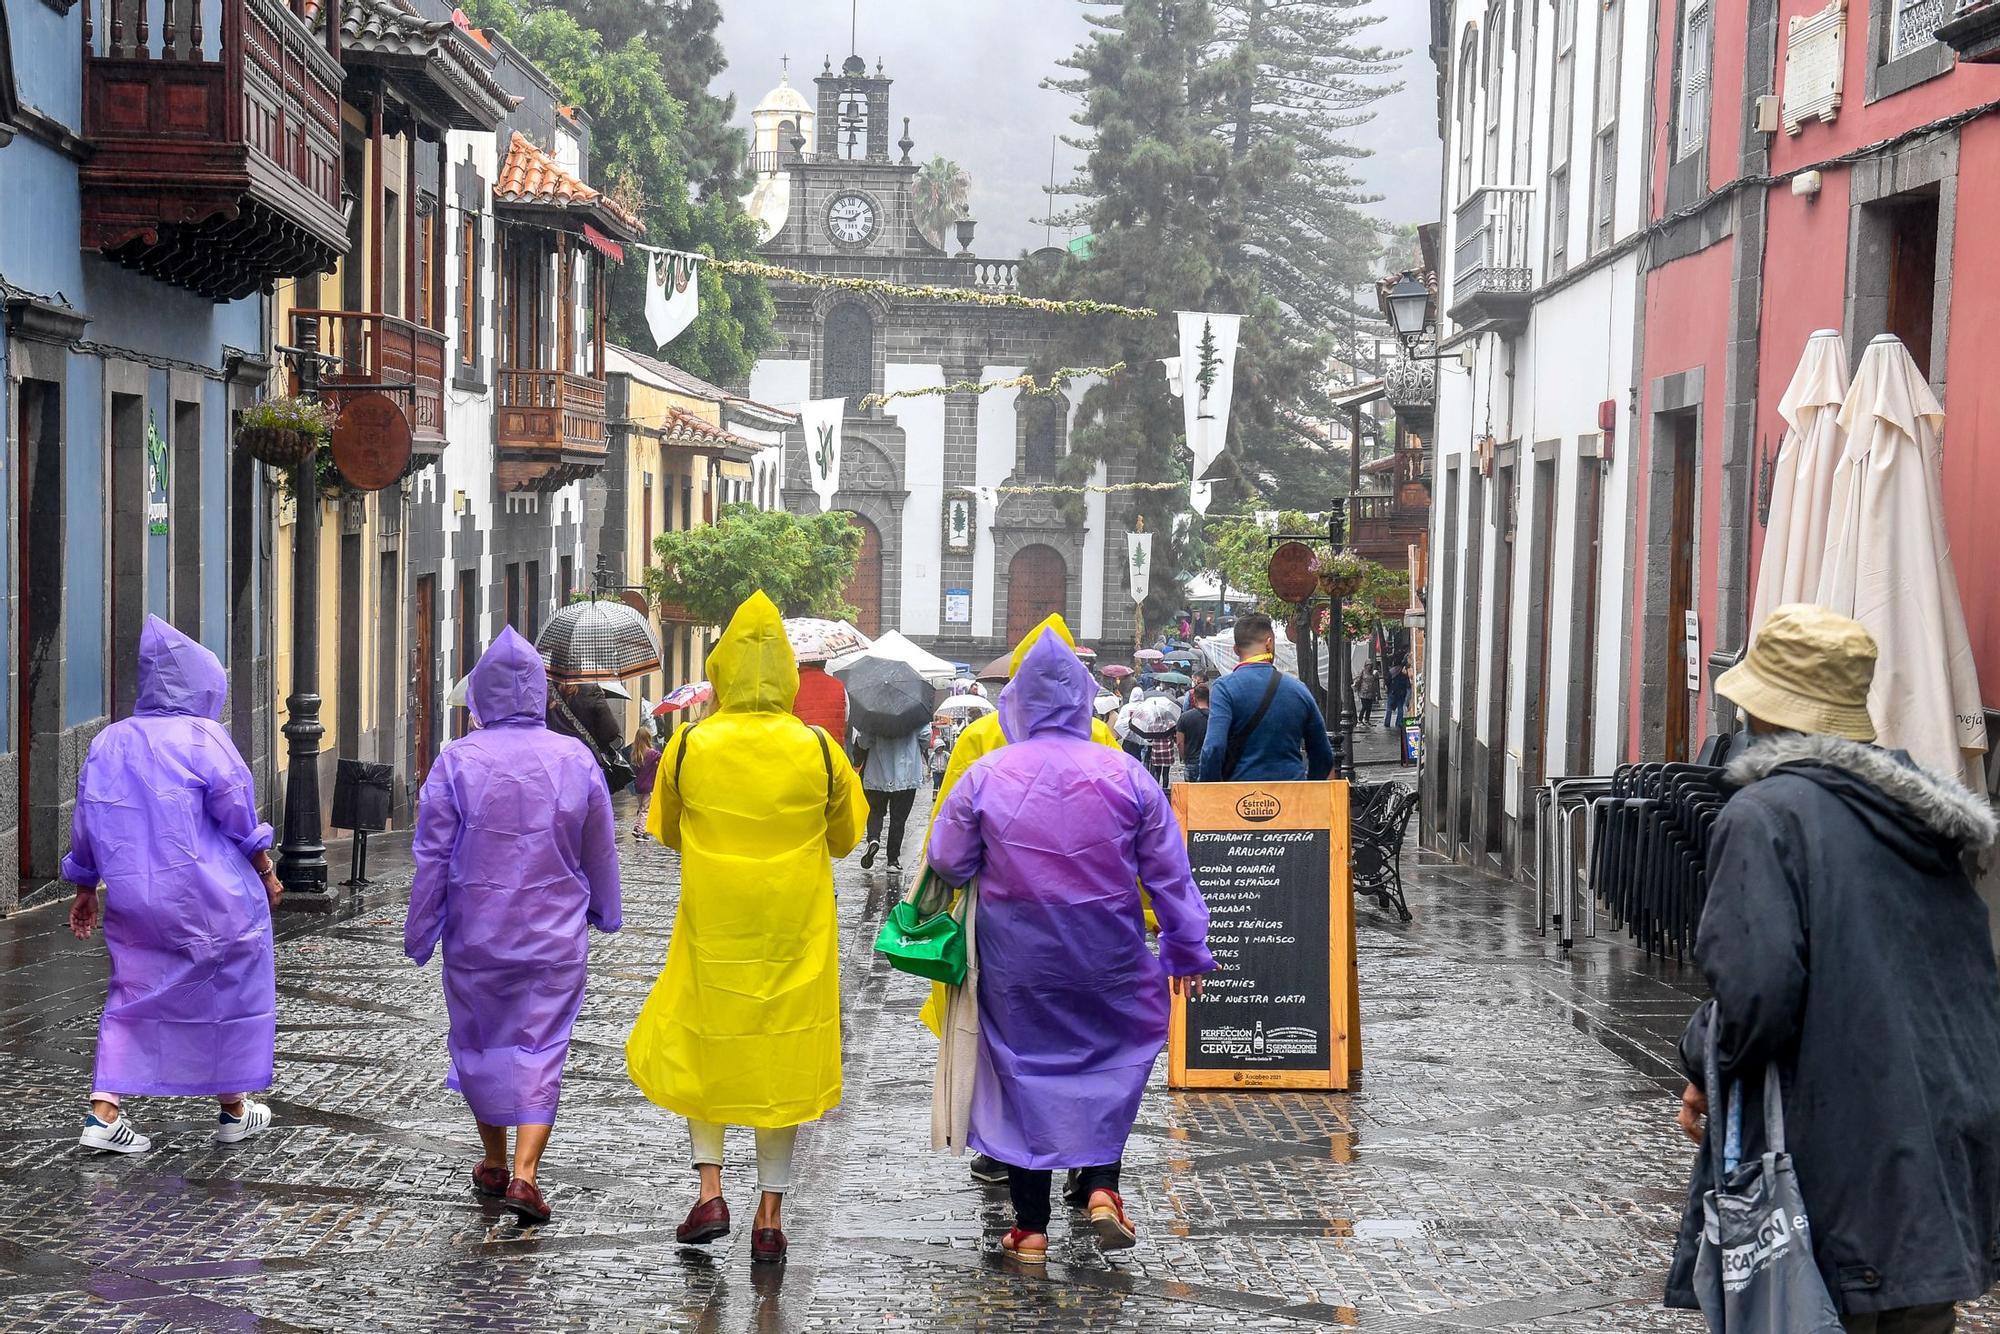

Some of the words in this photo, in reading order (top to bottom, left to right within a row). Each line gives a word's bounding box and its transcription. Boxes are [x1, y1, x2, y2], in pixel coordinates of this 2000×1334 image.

[1242, 799, 1275, 808] Estrella
[1243, 807, 1274, 816] Galicia
[1193, 832, 1253, 842] RESTAURANTE
[1234, 876, 1280, 887] ESPAÑOLA
[1207, 905, 1252, 913] NSALADAS
[1205, 935, 1240, 944] ESCADO
[1244, 936, 1251, 944] Y
[1252, 934, 1296, 944] MARISCO
[1225, 994, 1269, 1004] NUESTRA
[1274, 994, 1306, 1004] CARTA
[1200, 1028, 1253, 1037] PERFECCIÓN
[1200, 1043, 1253, 1054] CERVEZA
[1265, 1044, 1273, 1054] 5
